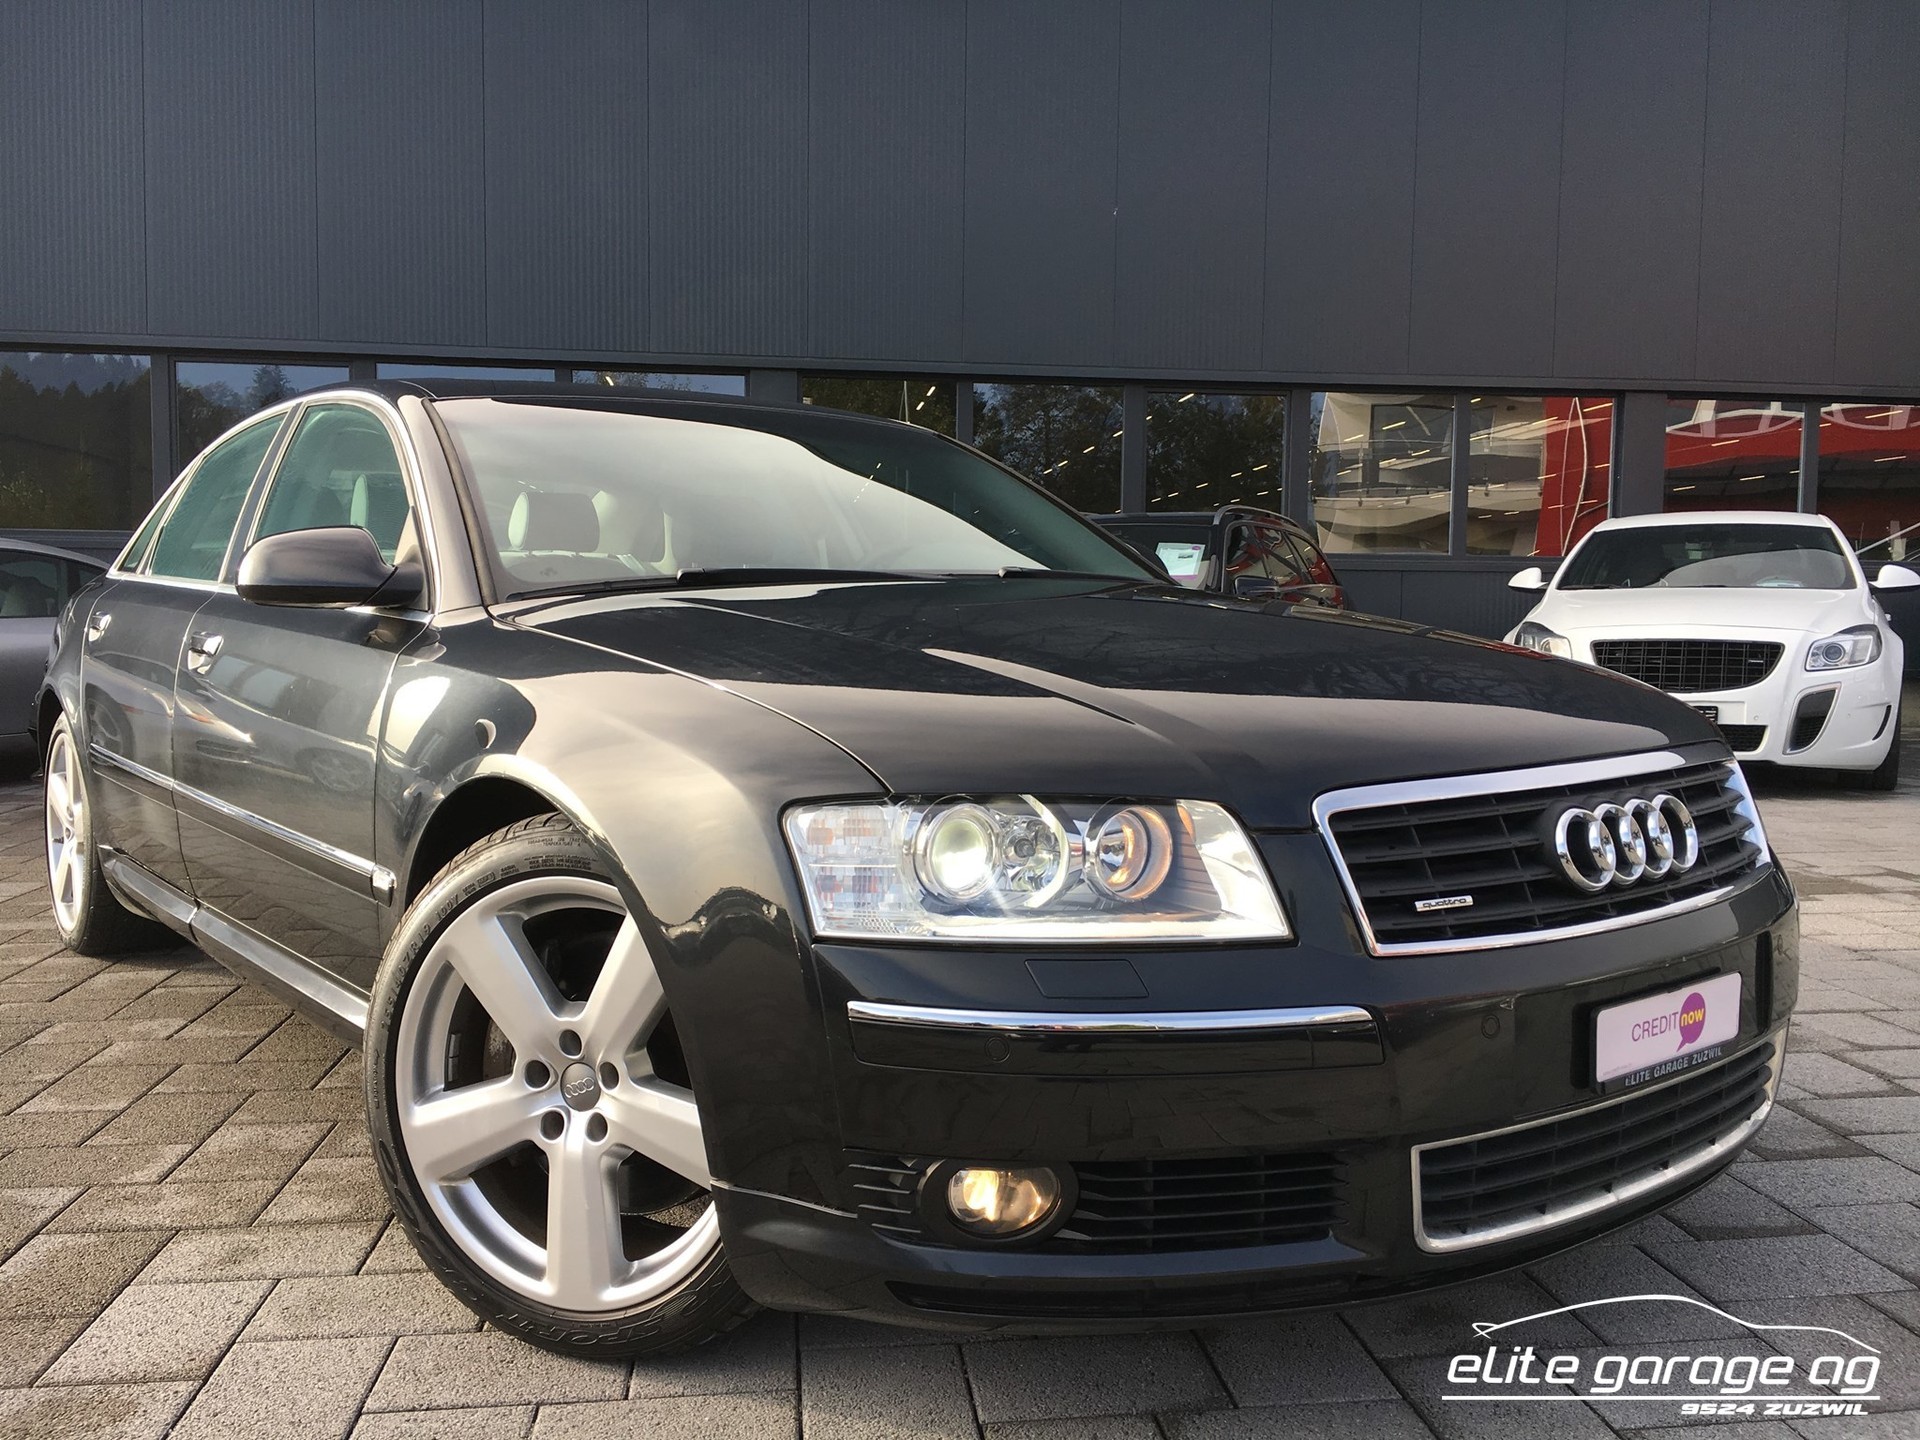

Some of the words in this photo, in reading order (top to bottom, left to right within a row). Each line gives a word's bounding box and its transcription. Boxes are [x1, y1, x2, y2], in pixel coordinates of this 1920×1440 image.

[1422, 898, 1468, 908] quattro
[1631, 1011, 1679, 1042] CREDIT
[1680, 1008, 1705, 1027] now
[1653, 1057, 1689, 1078] GARAGE
[1691, 1046, 1723, 1065] ZUZWIL
